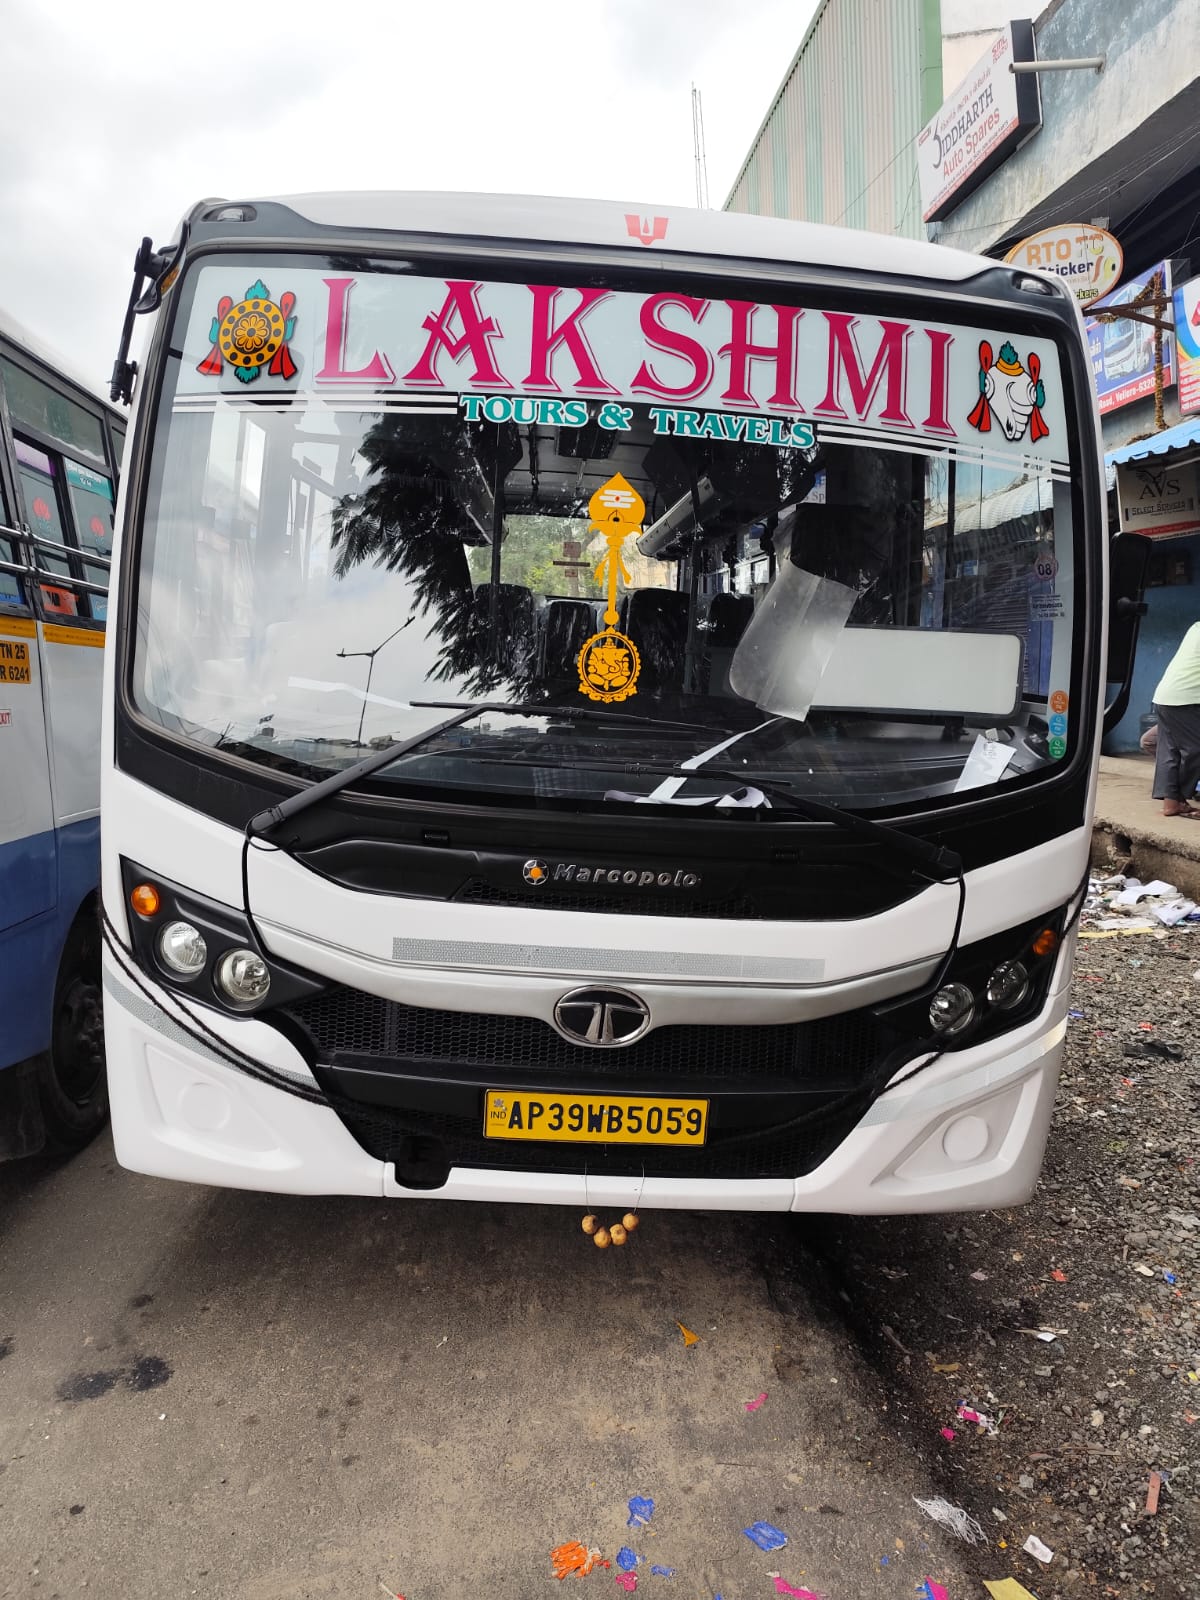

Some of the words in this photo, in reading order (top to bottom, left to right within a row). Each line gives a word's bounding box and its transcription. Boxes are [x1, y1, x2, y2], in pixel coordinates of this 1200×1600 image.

[932, 84, 994, 169] SIDDHARTH
[943, 147, 963, 180] Auto
[965, 107, 1001, 155] Spares
[1026, 238, 1072, 266] RTO
[314, 277, 958, 438] LAKSHMI
[1116, 376, 1157, 399] Vellore-6320
[459, 394, 588, 429] TOURS
[597, 402, 634, 431] &
[648, 407, 816, 450] TRAVELS
[1139, 473, 1181, 500] AVS
[0, 642, 13, 659] TN
[15, 644, 26, 660] 25
[9, 665, 30, 682] 6241
[553, 862, 699, 888] Marcopolo
[490, 1110, 507, 1120] IND
[508, 1100, 703, 1136] AP39WB5059
